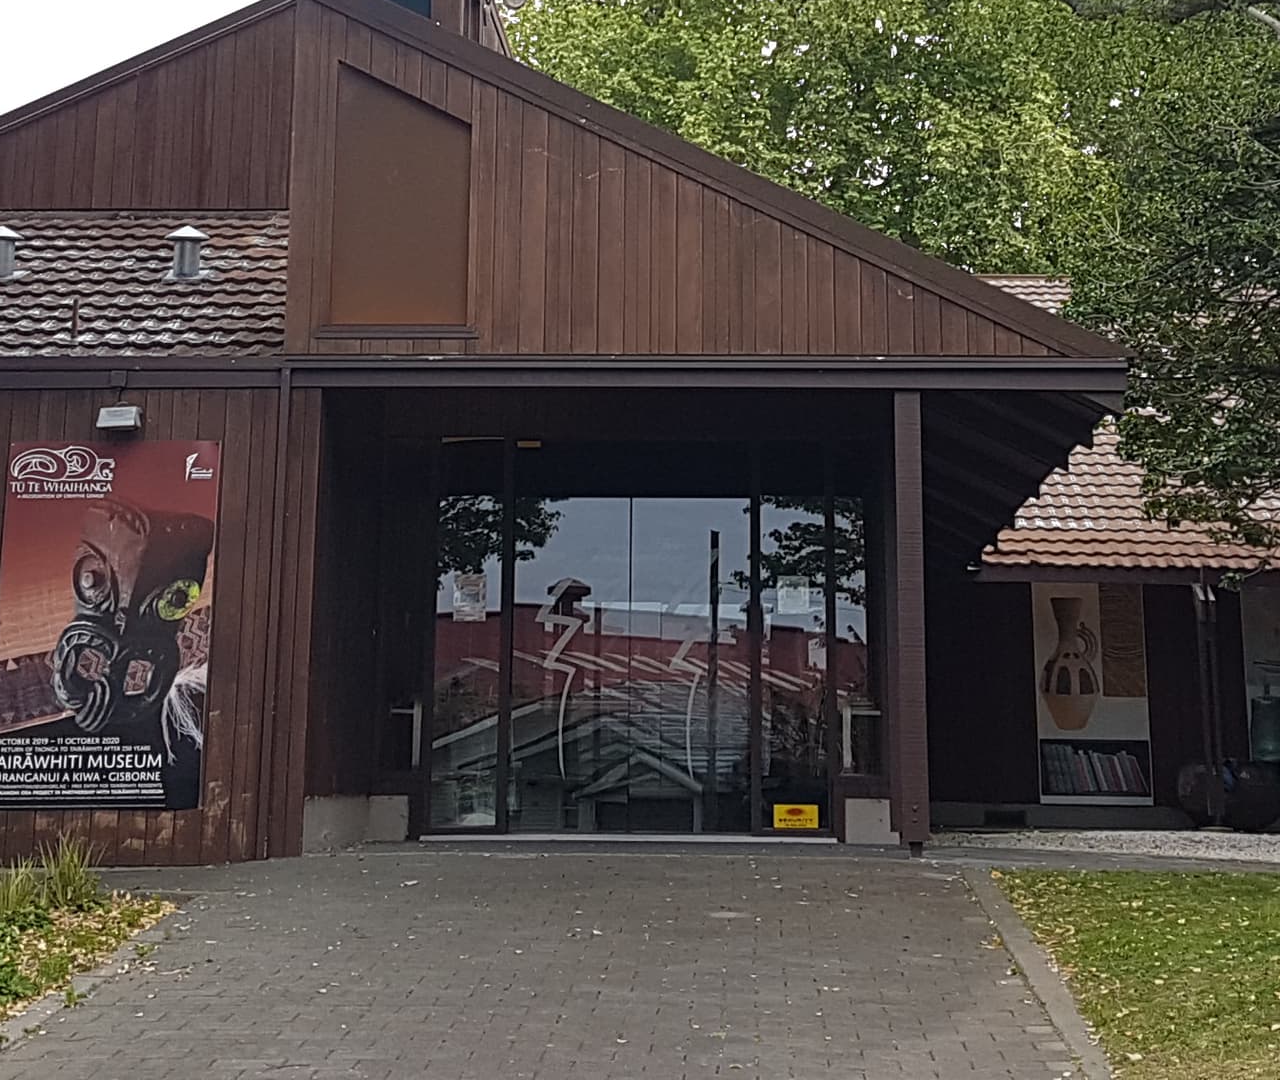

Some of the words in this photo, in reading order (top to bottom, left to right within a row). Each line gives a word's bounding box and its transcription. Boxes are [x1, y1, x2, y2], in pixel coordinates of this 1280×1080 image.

[27, 481, 40, 492] TE
[43, 481, 112, 493] WHAIHANGA
[65, 737, 100, 745] OCTOBER
[87, 753, 162, 768] MUSEUM
[62, 773, 70, 781] A
[73, 772, 100, 781] KIWA
[108, 771, 161, 781] GISBORNE
